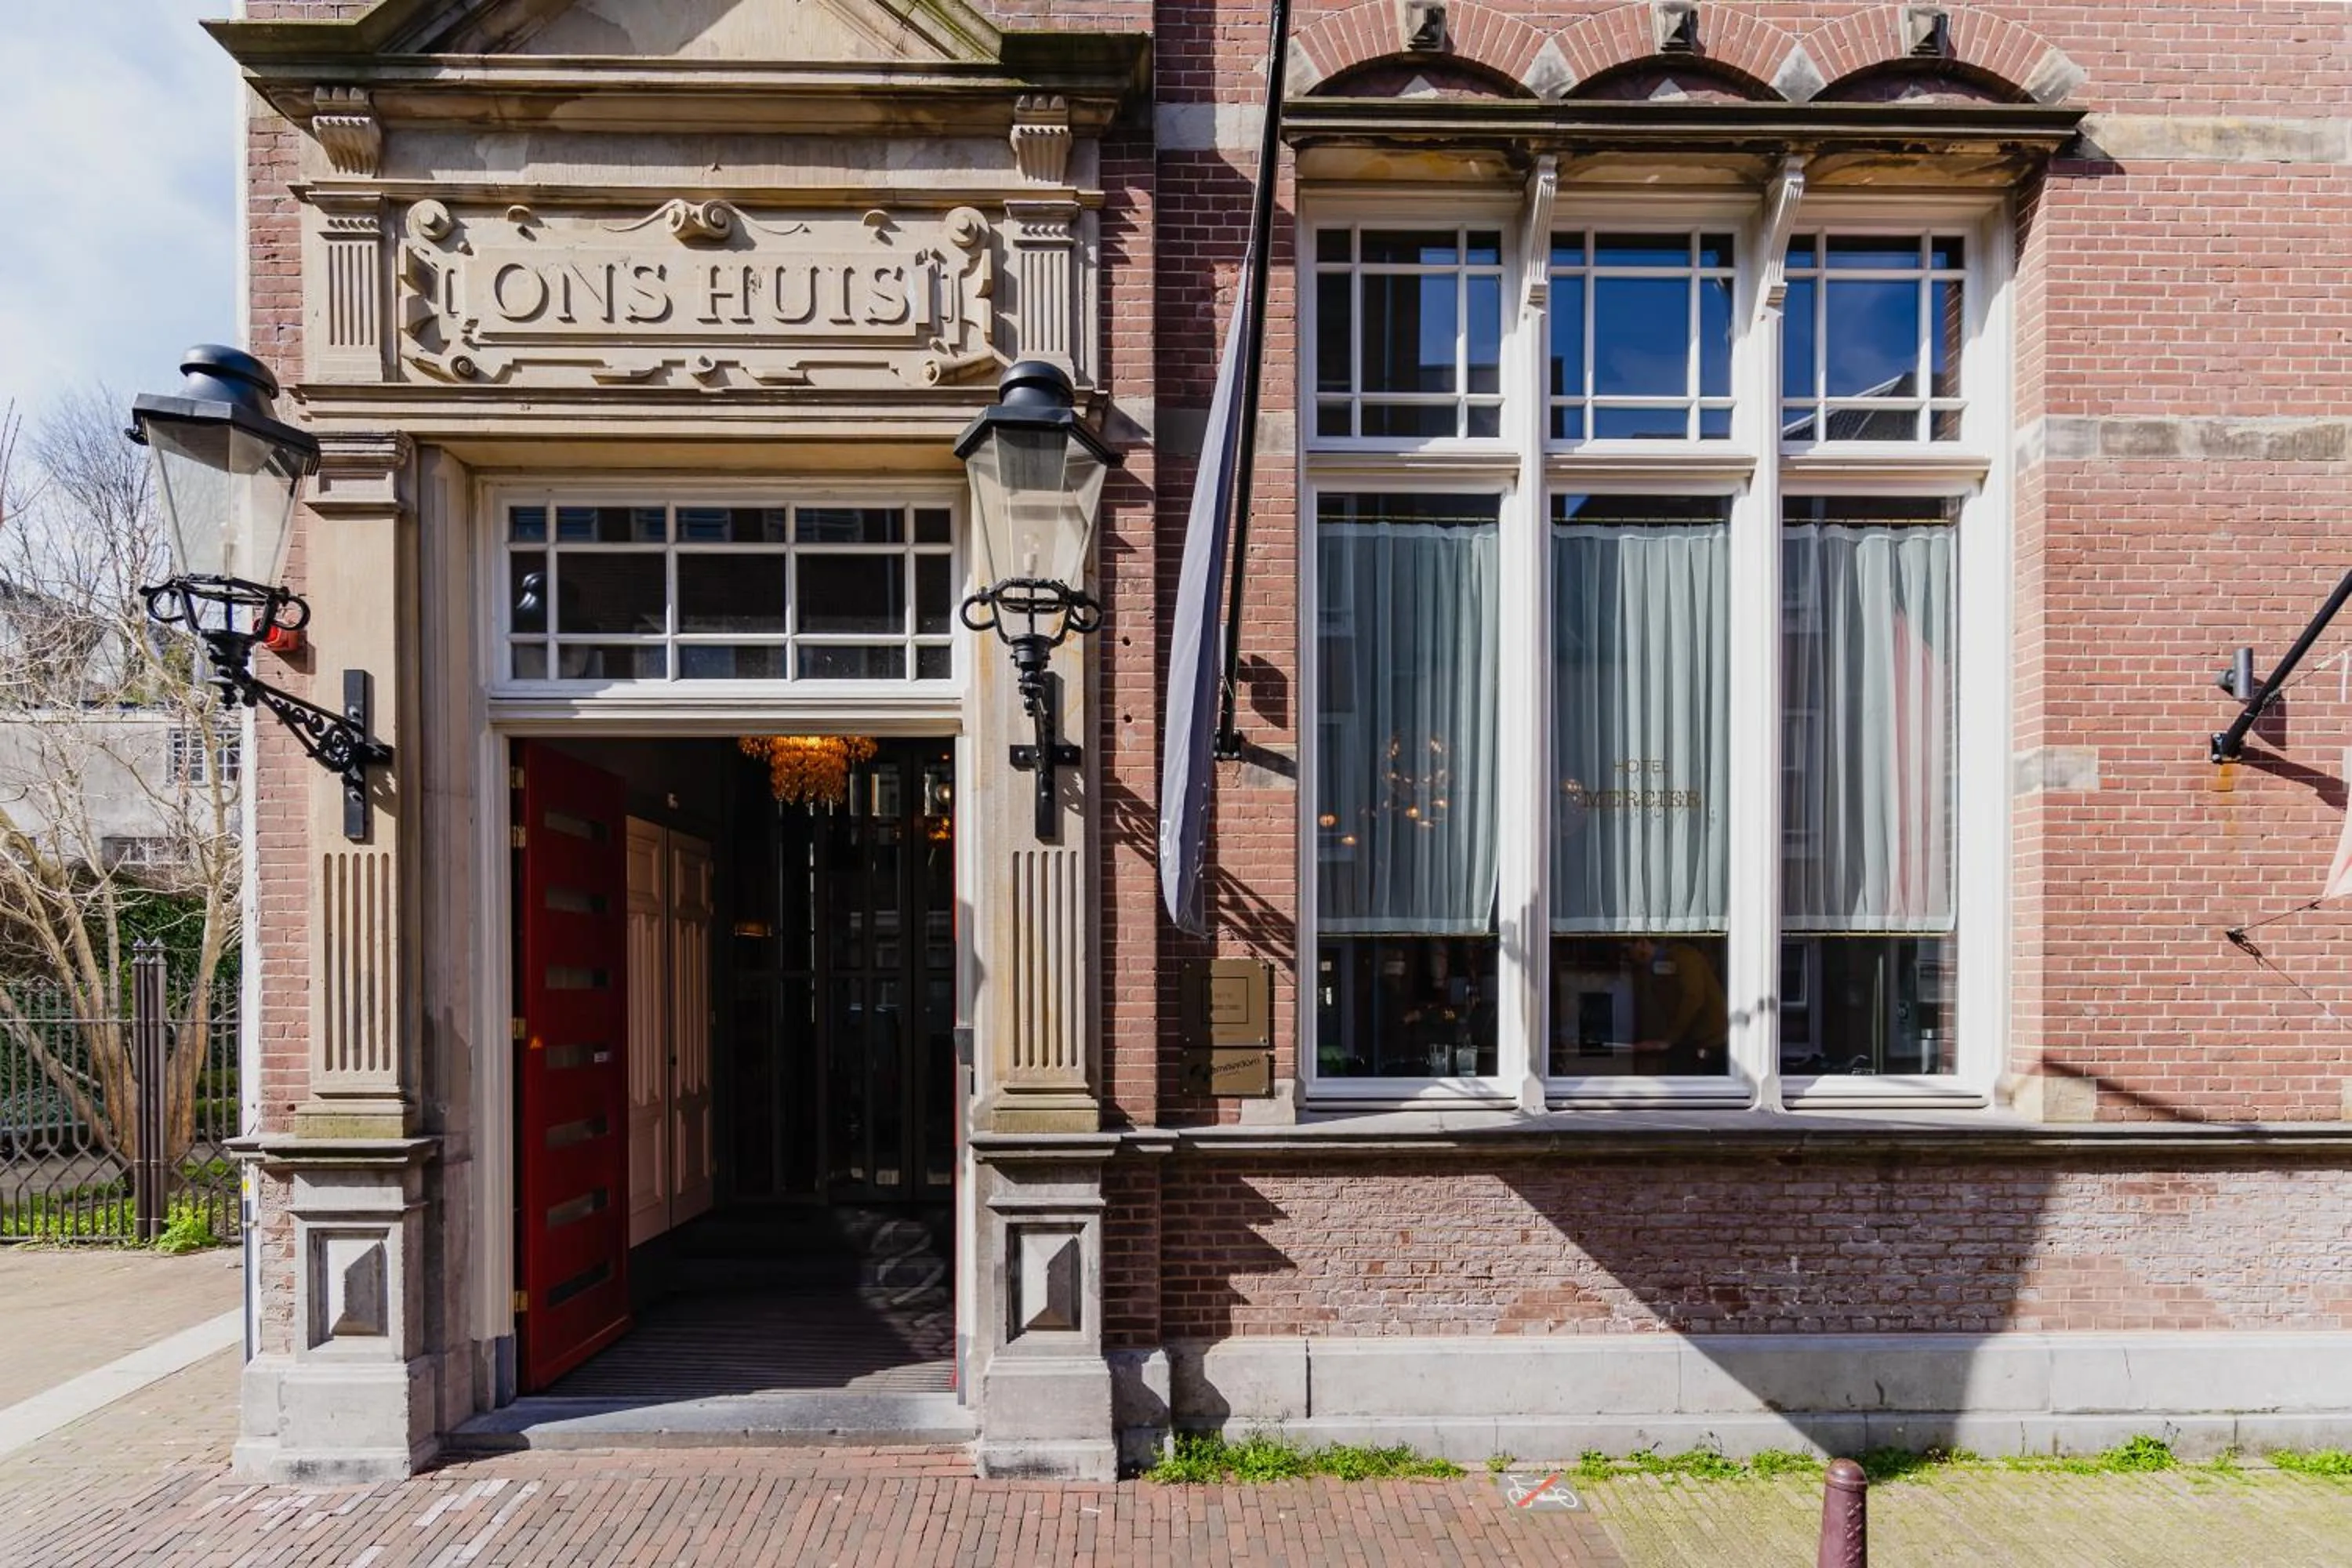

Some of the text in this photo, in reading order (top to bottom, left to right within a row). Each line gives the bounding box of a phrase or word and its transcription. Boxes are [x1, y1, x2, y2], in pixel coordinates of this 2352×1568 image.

[494, 263, 911, 326] ONS HUIS
[1614, 759, 1669, 774] HOTEL
[1583, 789, 1702, 808] MERCIER
